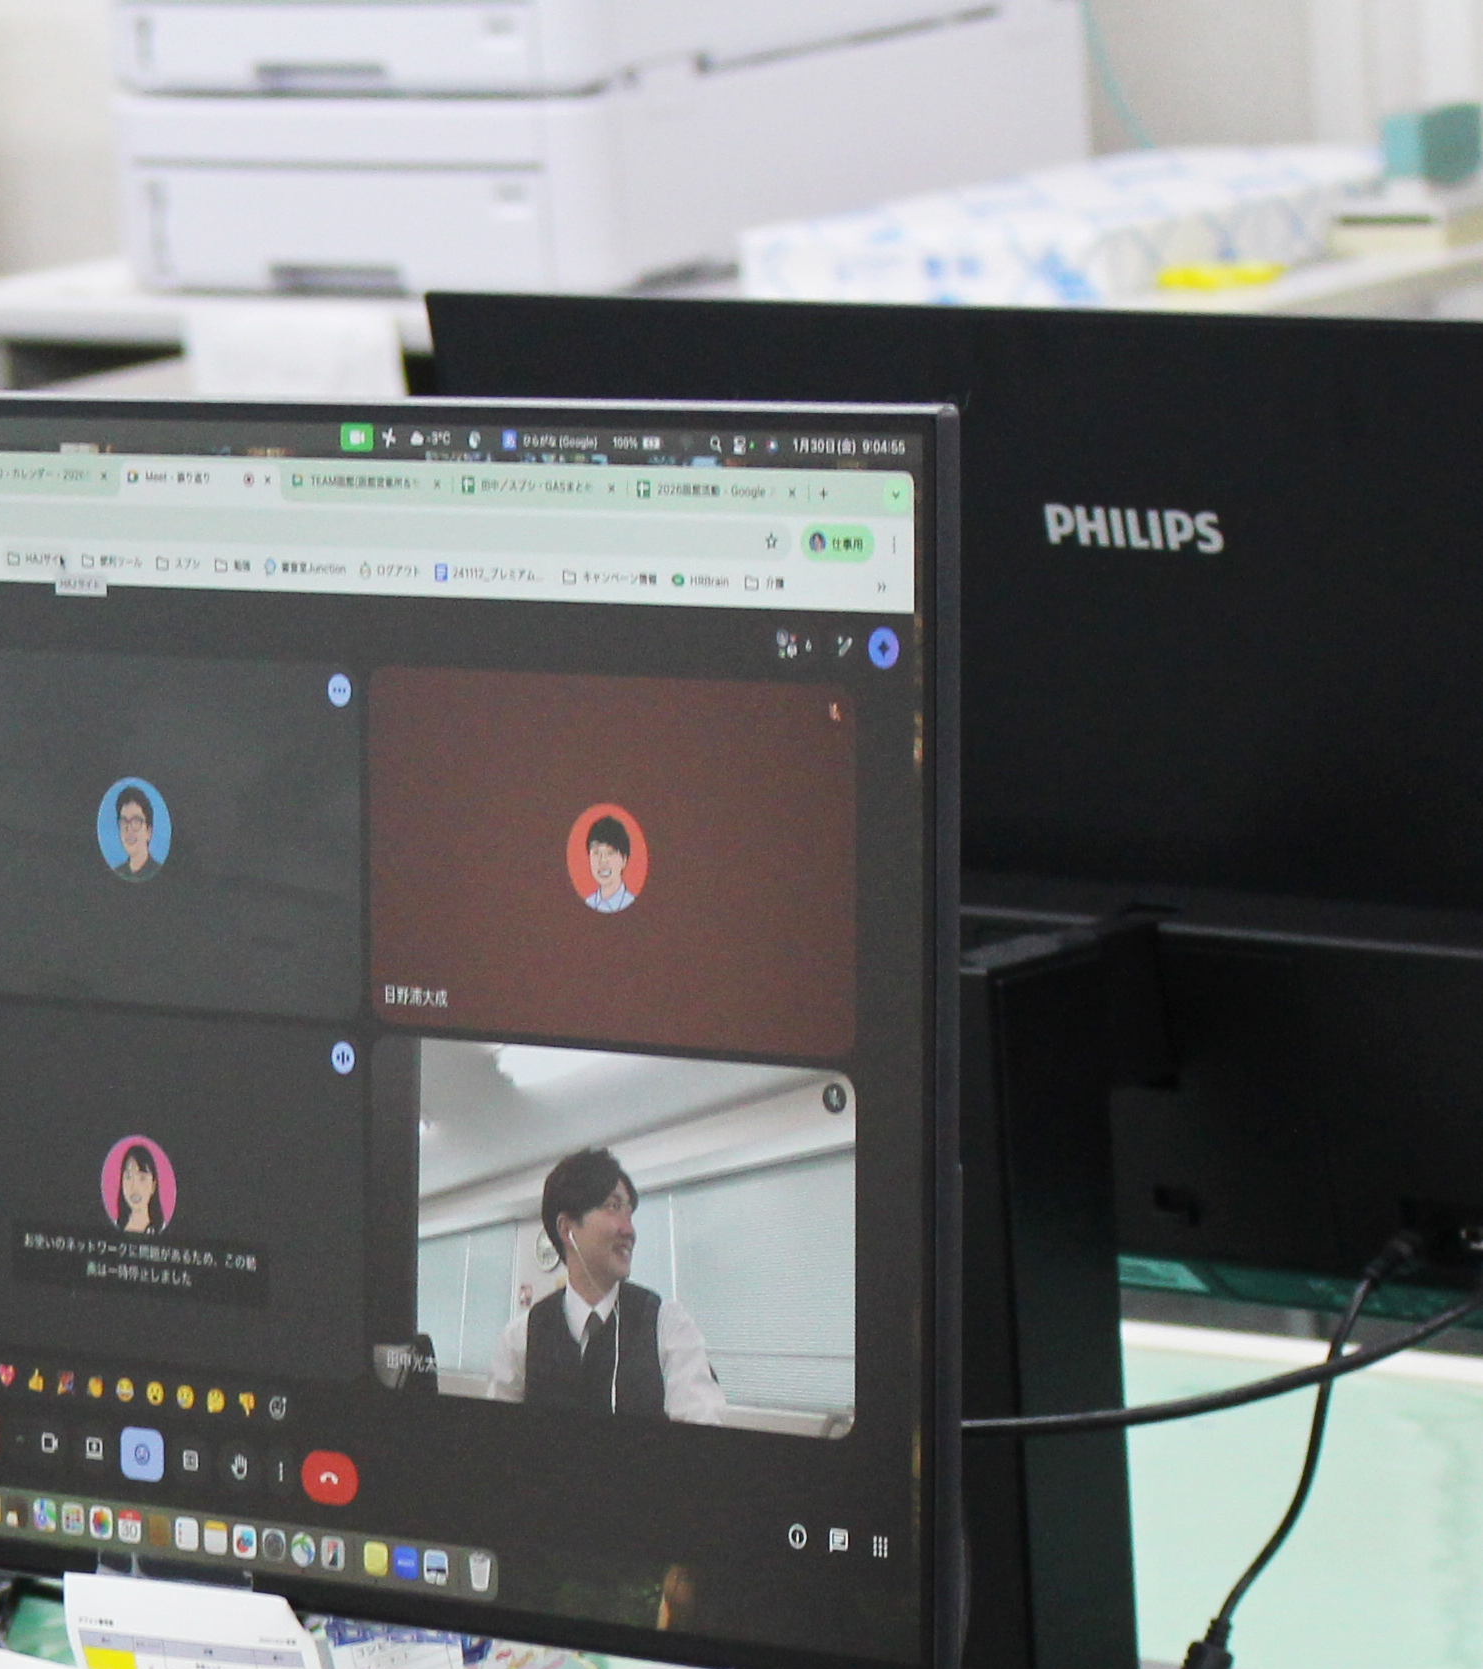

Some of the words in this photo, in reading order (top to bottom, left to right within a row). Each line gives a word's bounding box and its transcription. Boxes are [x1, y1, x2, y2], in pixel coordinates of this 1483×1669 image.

[1044, 504, 1223, 556] PHILIPS
[832, 537, 863, 550] 仕事用
[384, 985, 448, 1009] 日野浦大成
[24, 1233, 257, 1273] お使いのネットワークに問題があるため、この動
[86, 1263, 192, 1288] 画は一時停止しました
